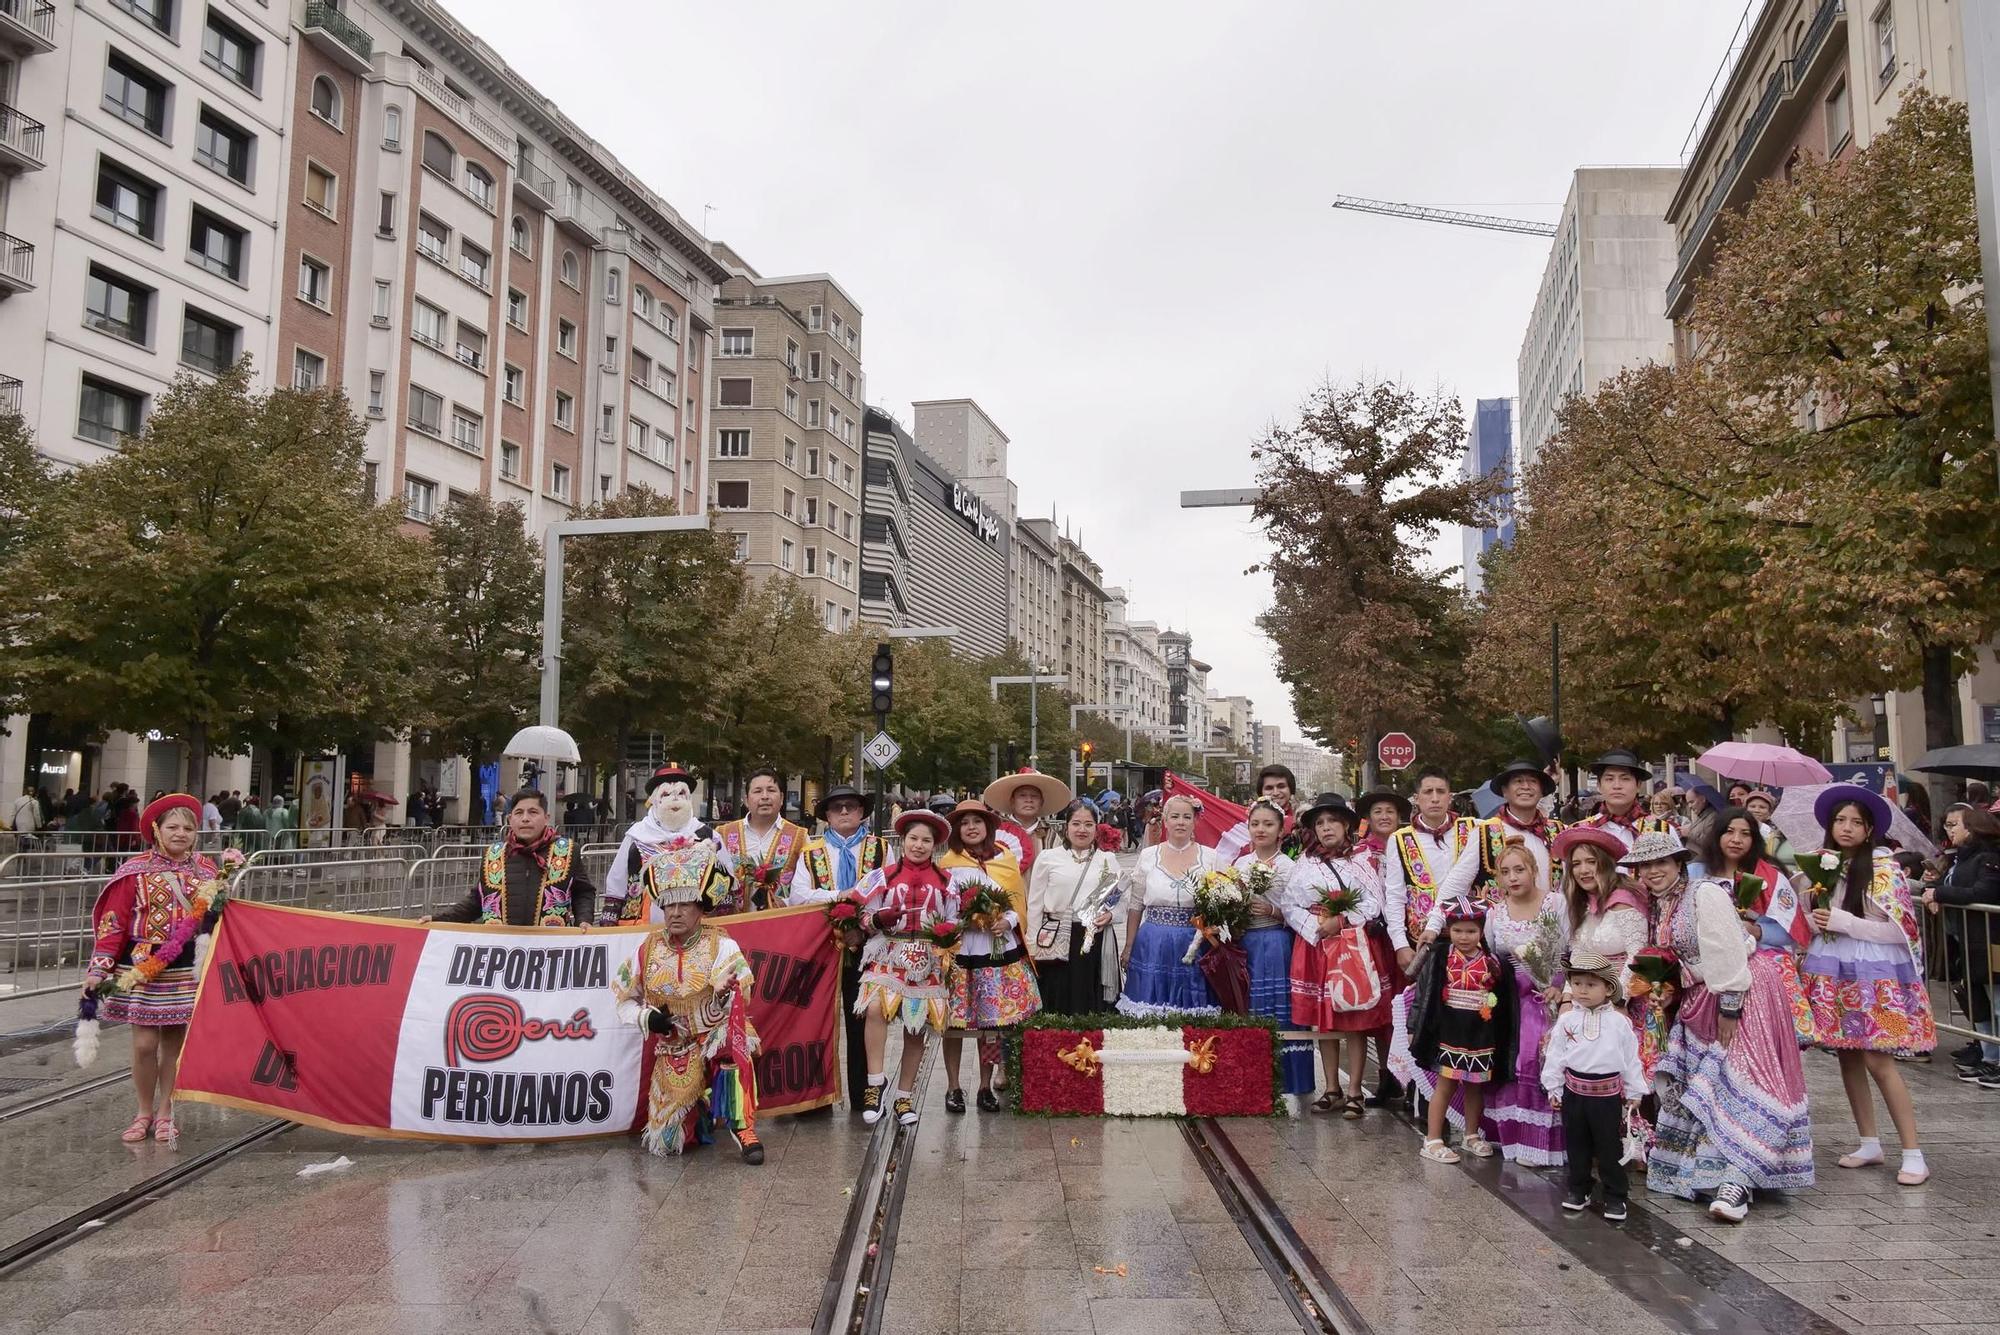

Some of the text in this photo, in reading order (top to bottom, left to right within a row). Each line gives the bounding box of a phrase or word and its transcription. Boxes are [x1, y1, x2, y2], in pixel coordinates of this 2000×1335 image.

[874, 744, 890, 757] 30
[1382, 746, 1412, 756] STOP
[40, 762, 67, 774] Aural
[446, 944, 609, 992] DEPORTIVA
[445, 993, 597, 1069] Perú
[421, 1066, 614, 1126] PERUANOS
